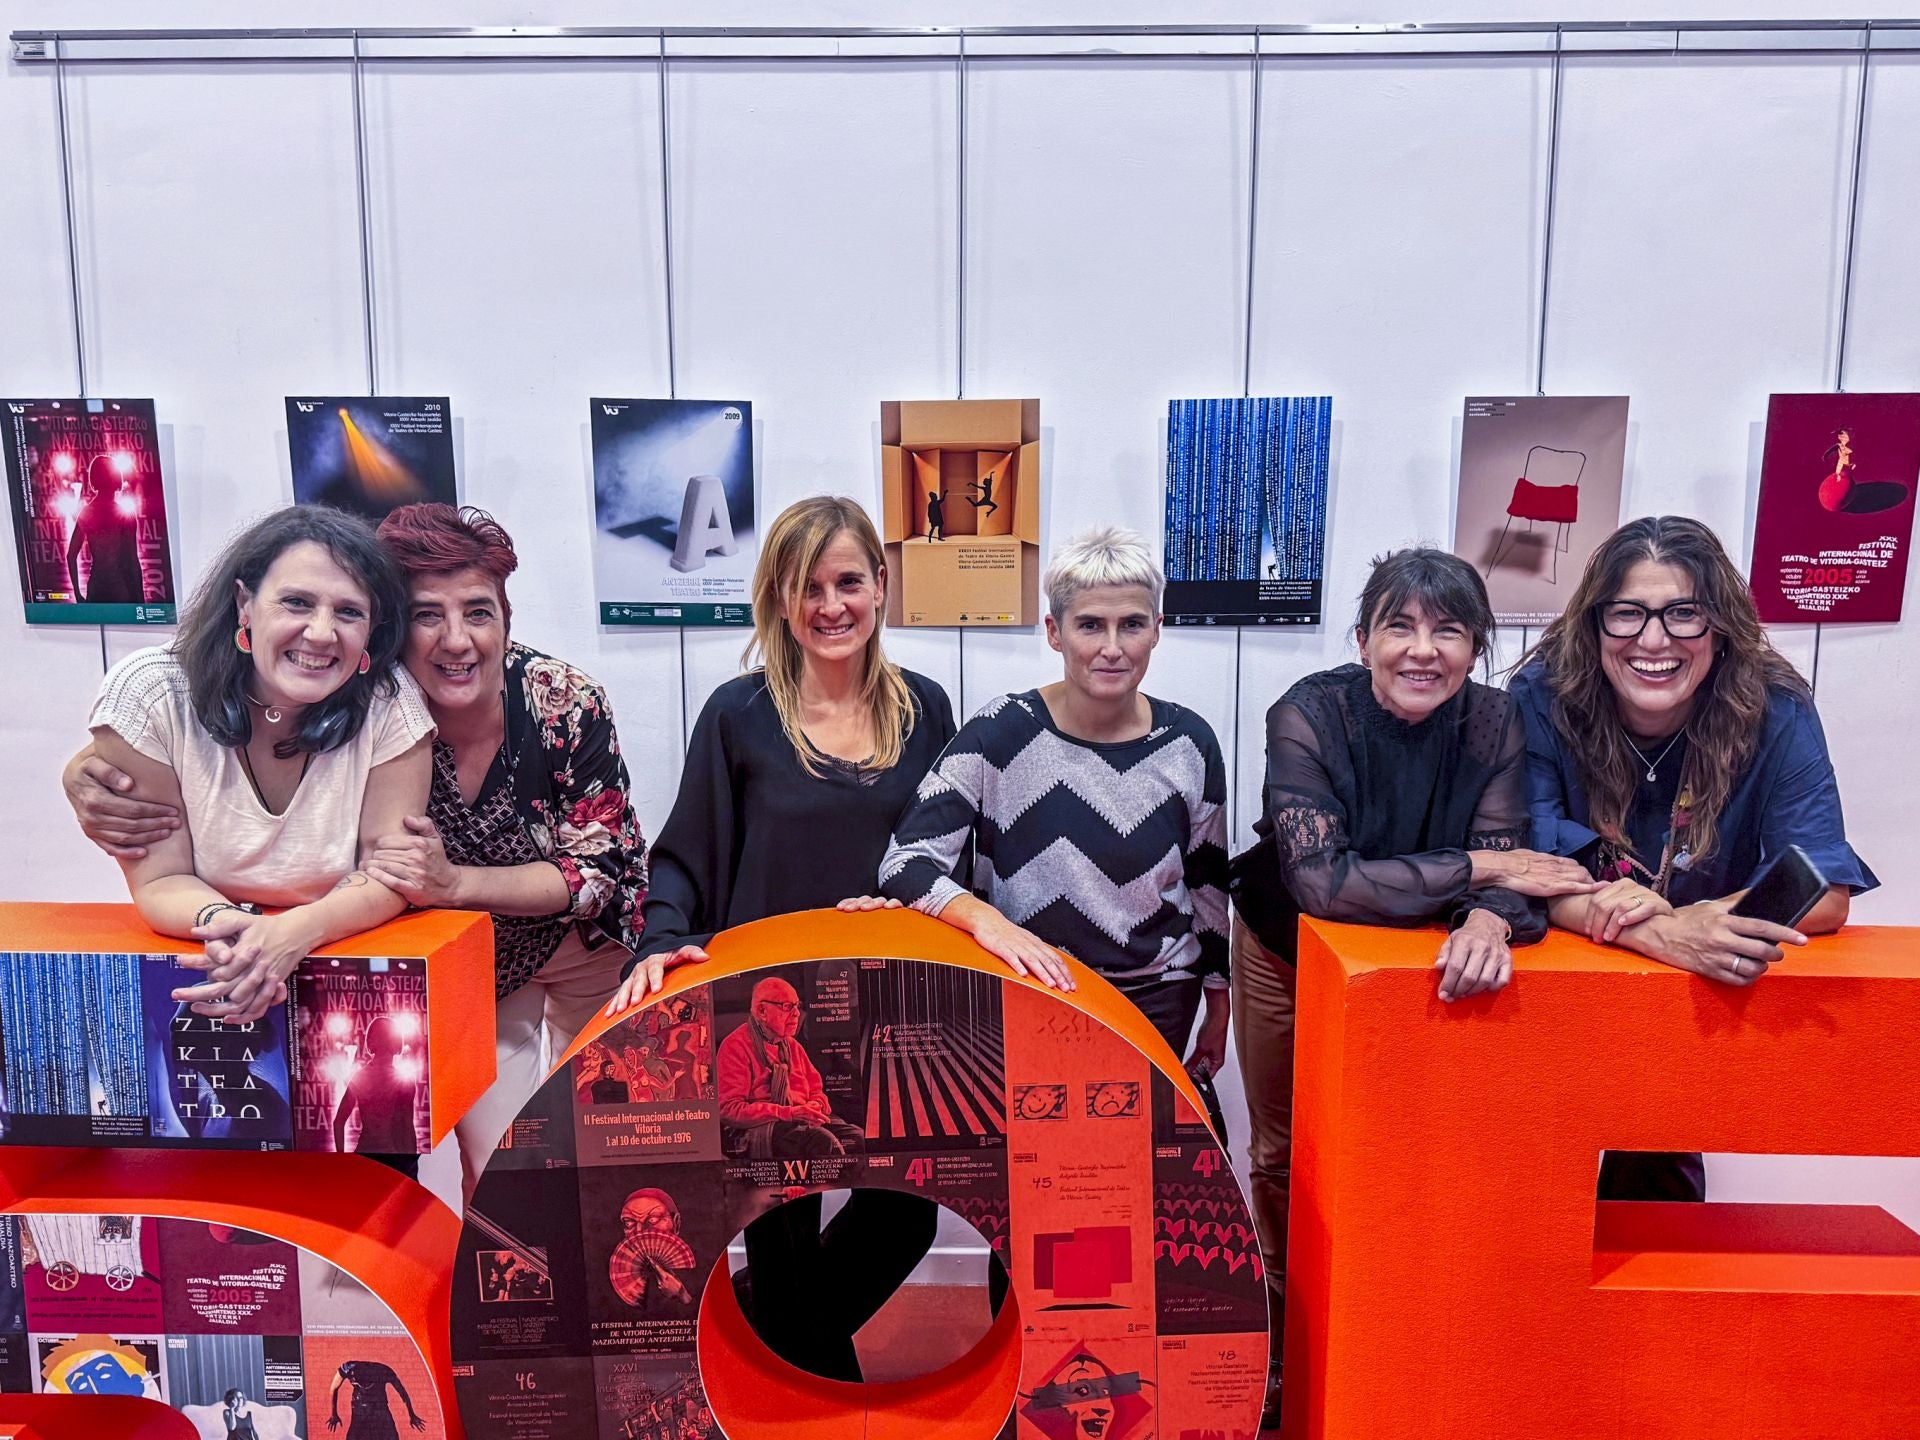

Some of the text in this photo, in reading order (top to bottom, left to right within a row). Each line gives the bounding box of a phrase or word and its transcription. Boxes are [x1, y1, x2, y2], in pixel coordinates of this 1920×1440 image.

[52, 432, 144, 450] NAZIOARTEKO
[1858, 541, 1897, 550] FESTIVAL
[1880, 550, 1893, 558] DE
[1781, 555, 1809, 563] TEATRO
[1820, 558, 1888, 568] VITORIA-GASTEIZ
[145, 543, 166, 600] 2011
[1803, 568, 1853, 585] 2005
[1781, 586, 1860, 595] VITORIA-GASTEIZKO
[872, 1023, 892, 1043] 42
[584, 1109, 710, 1125] II Festival Internacional de Teatro
[634, 1124, 662, 1134] Vitoria
[606, 1132, 692, 1147] 1 al 10 de octubre 1976
[783, 1160, 809, 1180] XV
[1192, 1149, 1221, 1178] 41
[905, 1158, 933, 1186] 41
[1032, 1177, 1052, 1189] 45
[209, 1289, 252, 1303] 2005
[592, 1337, 645, 1346] NAZIOARTEKO
[1218, 1350, 1236, 1360] 48
[613, 1363, 638, 1373] XXVI
[515, 1372, 536, 1390] 46
